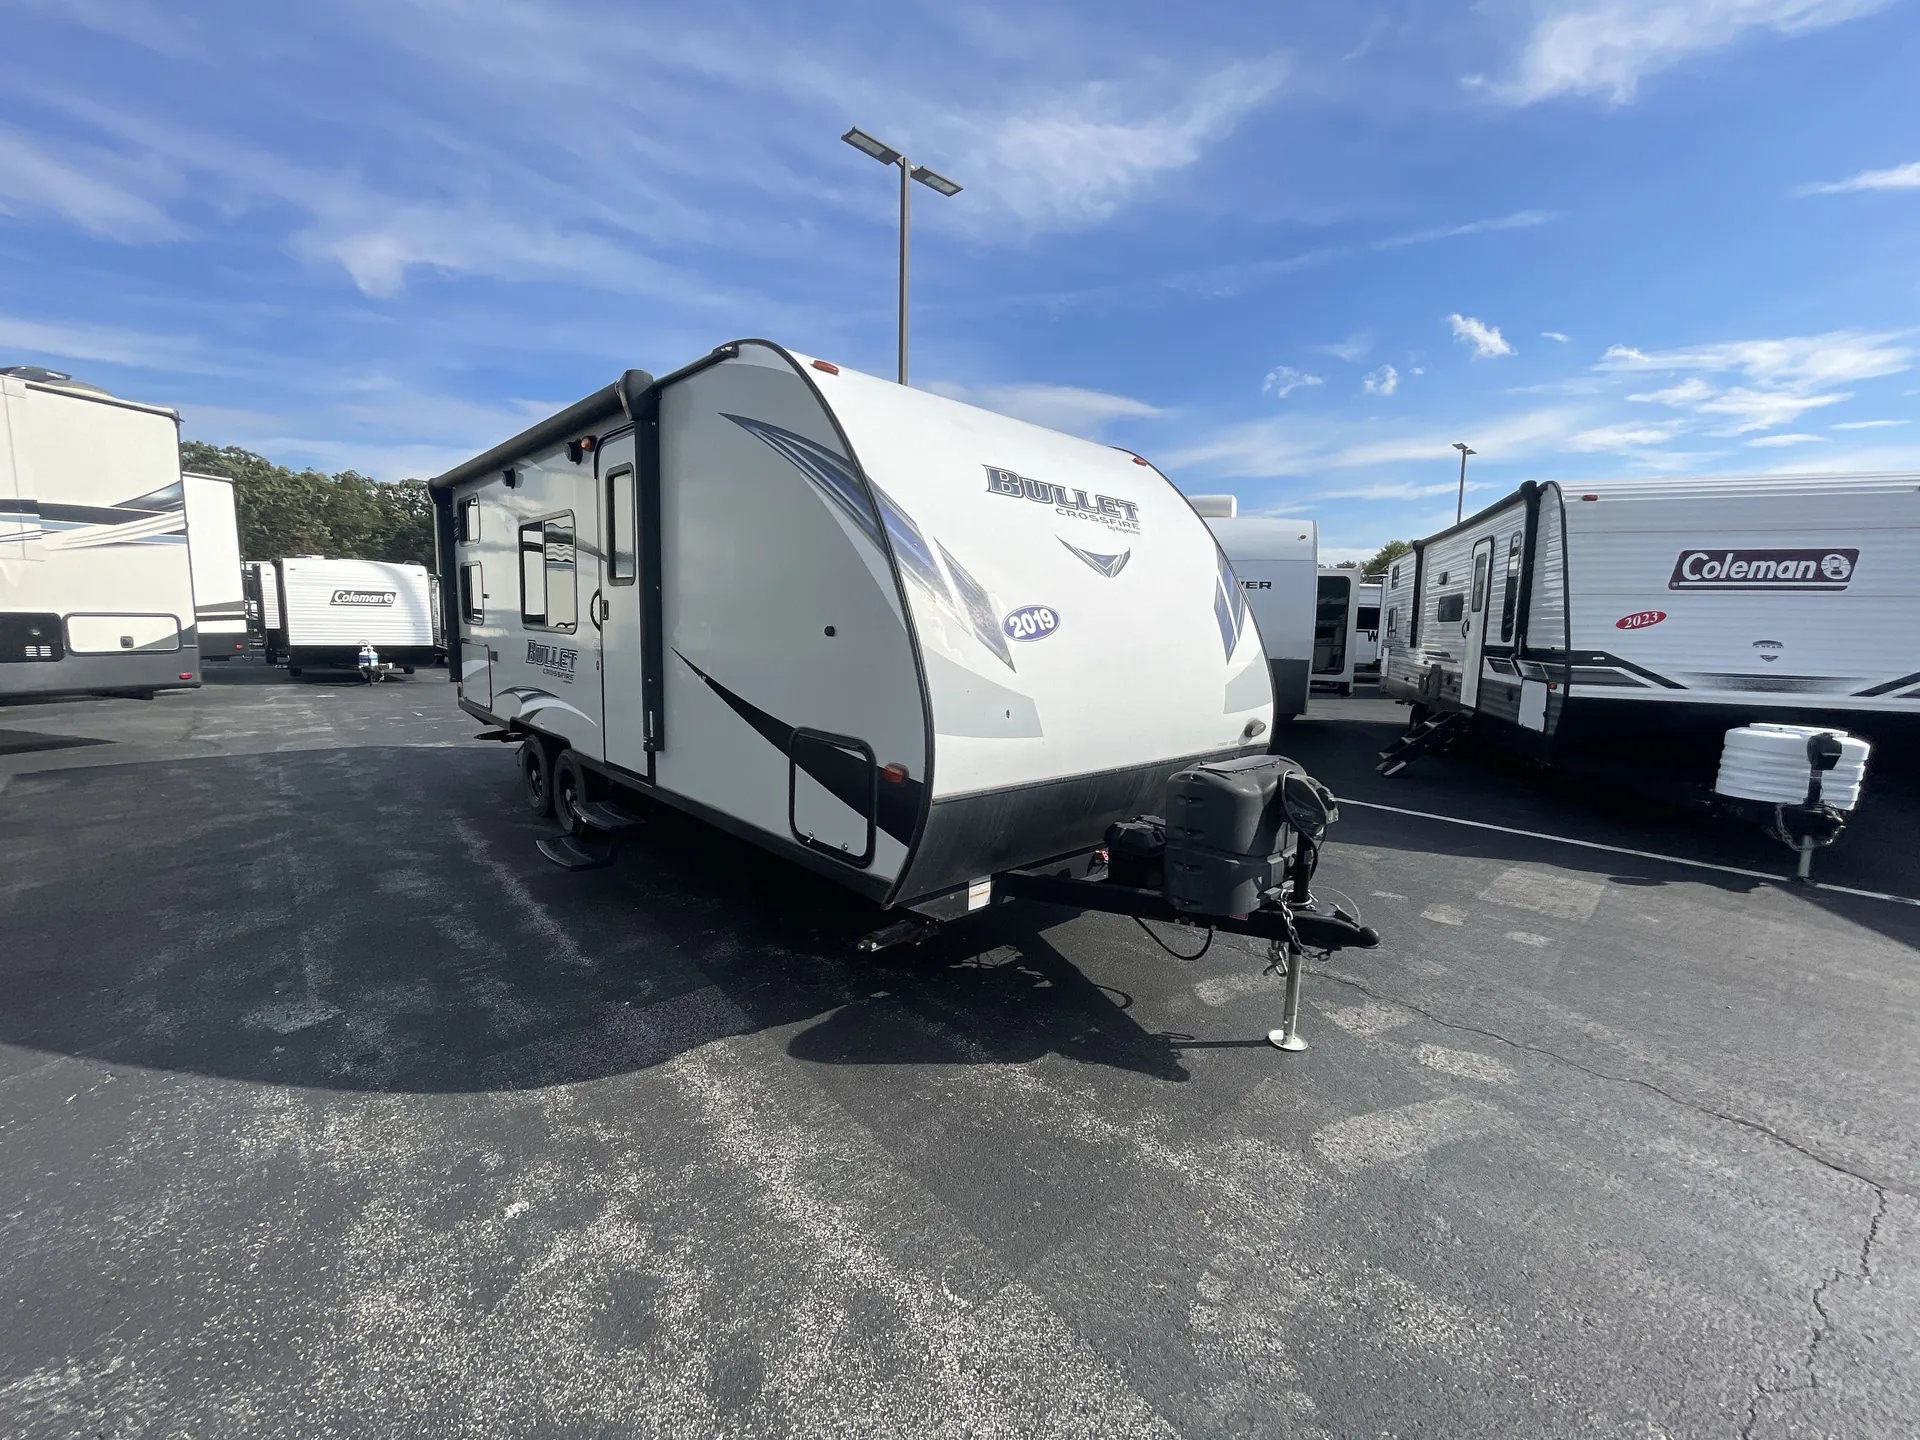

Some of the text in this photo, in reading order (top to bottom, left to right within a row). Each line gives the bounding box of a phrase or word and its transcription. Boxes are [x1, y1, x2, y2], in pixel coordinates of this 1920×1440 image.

[1055, 508, 1140, 530] CROSSFIRE
[1682, 552, 1817, 580] Coleman
[334, 590, 383, 603] Coleman
[1009, 608, 1055, 638] 2019
[1624, 611, 1659, 629] 2023
[543, 668, 574, 681] CROSSFIRE
